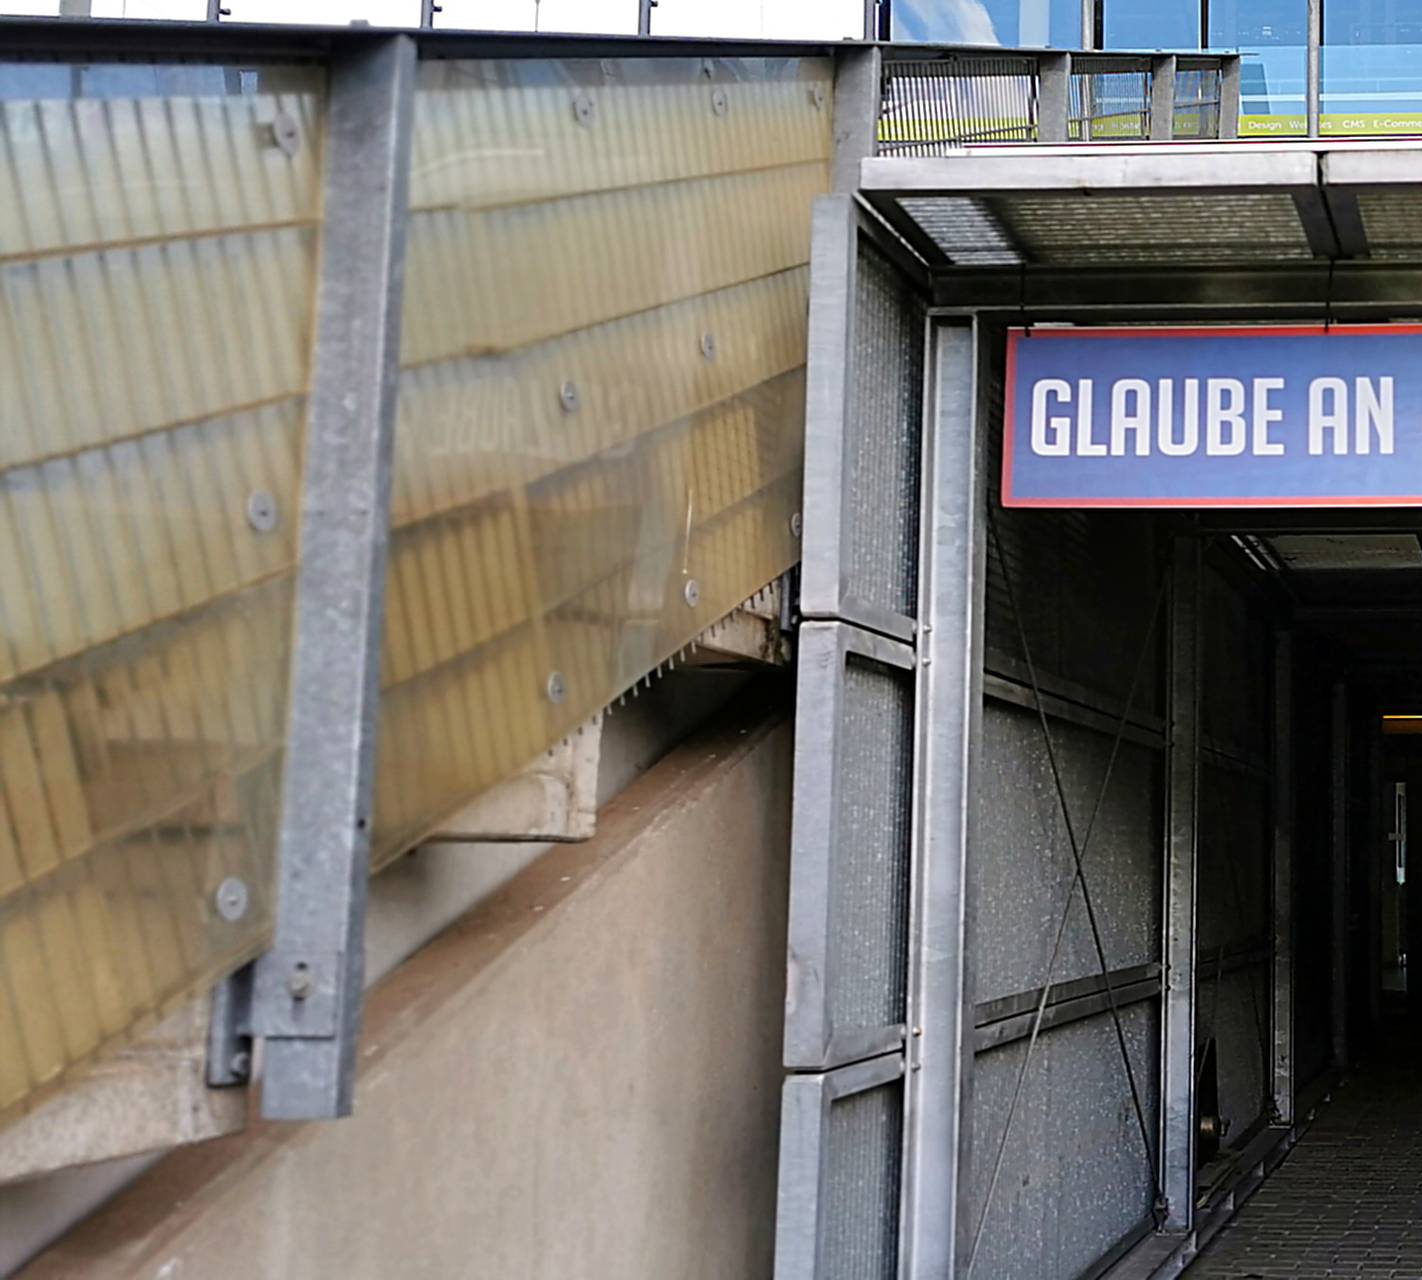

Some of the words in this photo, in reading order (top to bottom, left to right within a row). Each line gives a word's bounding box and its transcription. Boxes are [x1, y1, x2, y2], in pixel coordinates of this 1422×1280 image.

[1248, 121, 1283, 132] Design
[1342, 119, 1366, 129] CMS
[1030, 377, 1285, 457] GLAUBE
[1308, 375, 1394, 456] AN
